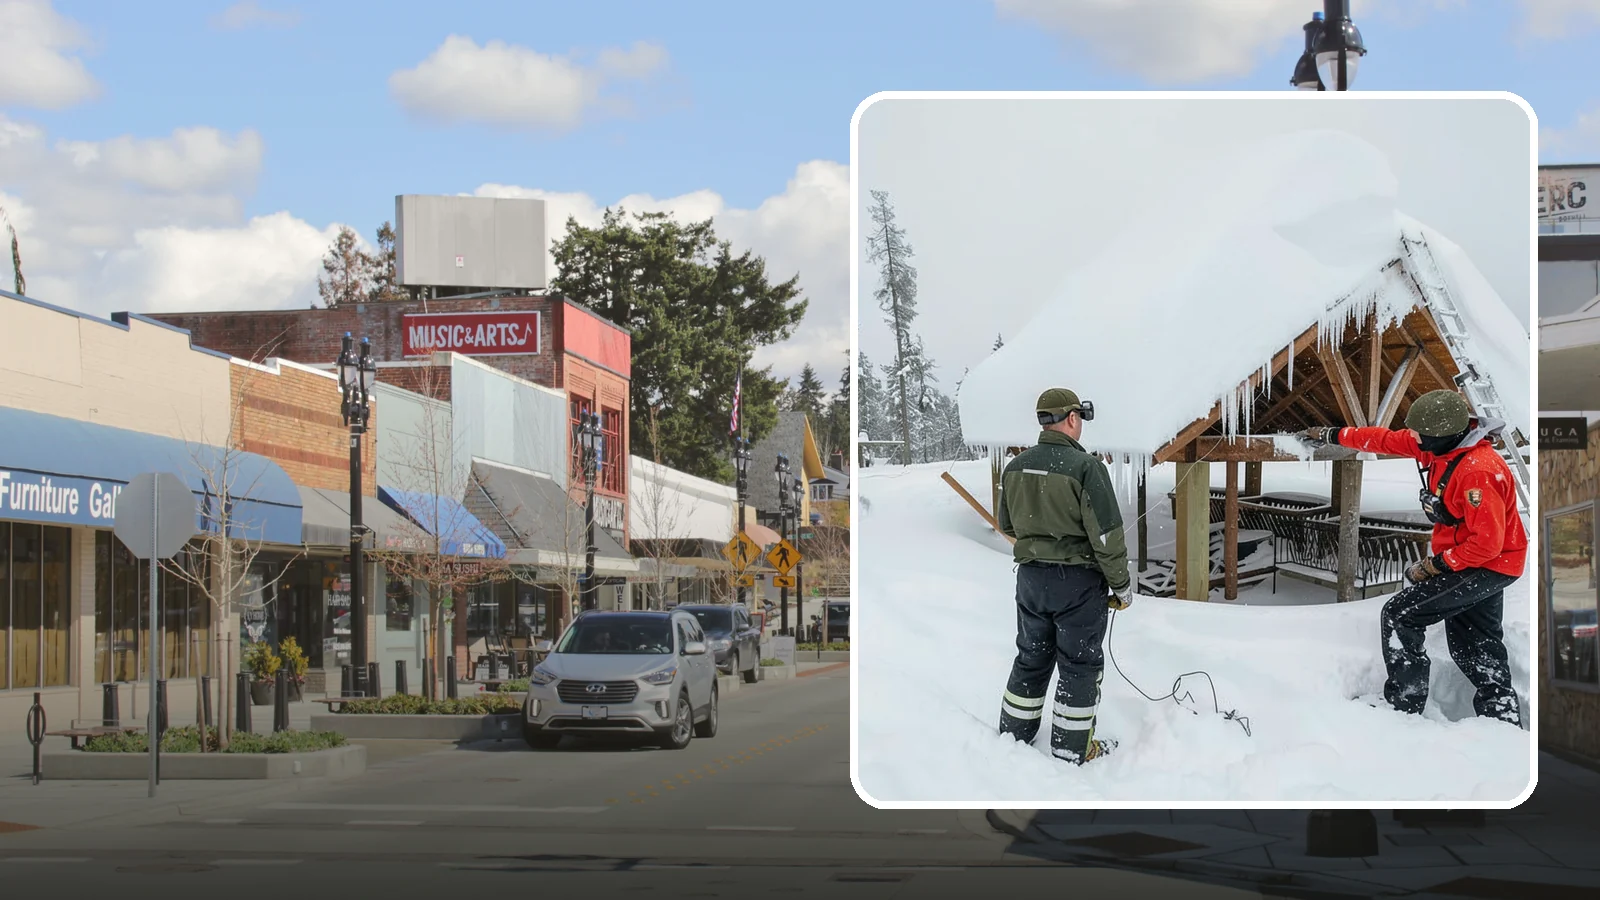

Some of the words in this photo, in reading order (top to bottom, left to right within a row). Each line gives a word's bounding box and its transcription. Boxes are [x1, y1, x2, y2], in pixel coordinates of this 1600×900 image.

[409, 323, 519, 348] MUSIC&ARTS
[0, 472, 79, 515] Furniture
[89, 482, 121, 519] Gal
[454, 563, 479, 574] SUSHI
